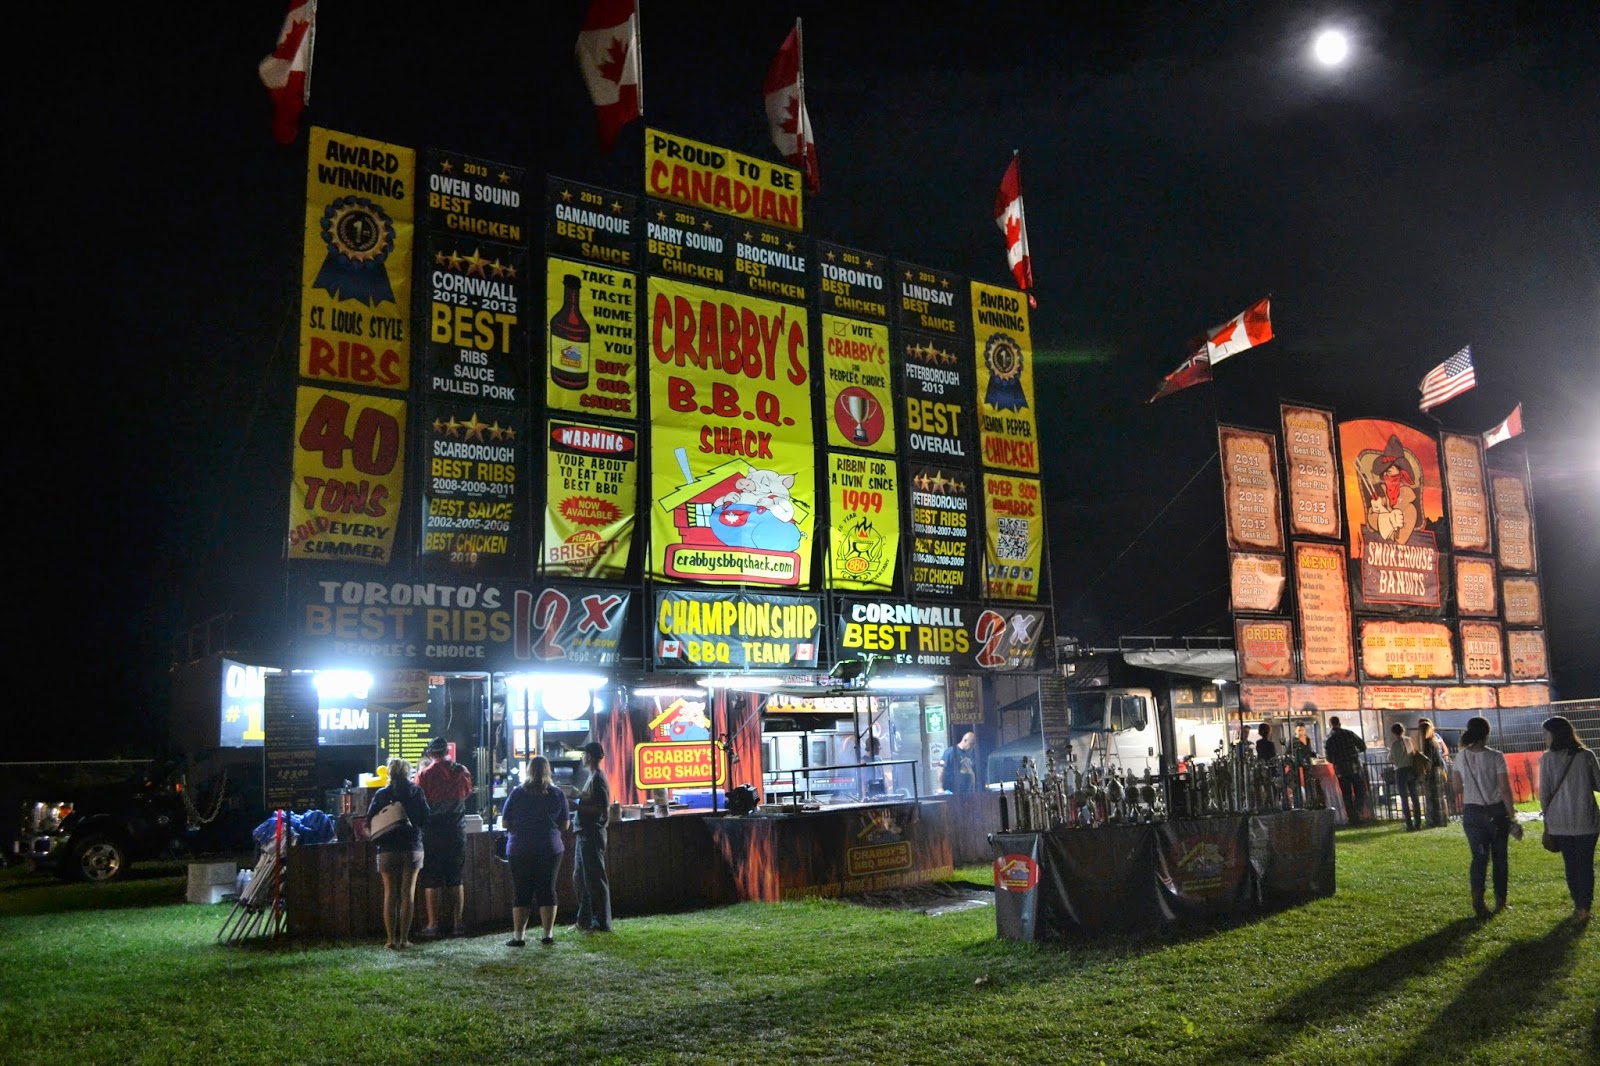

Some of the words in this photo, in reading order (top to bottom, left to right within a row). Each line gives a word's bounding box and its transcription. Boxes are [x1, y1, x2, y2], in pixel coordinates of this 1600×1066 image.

[326, 140, 398, 174] AWARD
[653, 135, 725, 170] PROUD
[736, 159, 760, 181] TO
[770, 169, 795, 191] BE
[463, 163, 488, 177] 2013
[318, 163, 404, 200] WINNING
[430, 174, 470, 198] OWEN
[474, 184, 520, 208] SOUND
[429, 192, 471, 215] BEST
[580, 191, 603, 205] 2013
[650, 159, 798, 228] CANADIAN
[447, 213, 520, 241] CHICKEN
[555, 203, 630, 235] GANANOQUE
[675, 212, 695, 225] 2013
[556, 220, 595, 242] BEST
[647, 222, 683, 246] PARRY
[685, 232, 723, 254] SOUND
[760, 232, 780, 245] 2013
[581, 241, 631, 266] SAUCE
[647, 241, 682, 259] BEST
[736, 242, 805, 273] BROCKVILLE
[842, 252, 860, 265] 2013
[662, 258, 723, 283] CHICKEN
[735, 257, 767, 279] BEST
[821, 262, 883, 290] TORONTO
[918, 272, 935, 284] 2013
[432, 271, 517, 302] CORNWALL
[581, 269, 615, 286] TAKE
[622, 277, 632, 290] A
[749, 276, 805, 300] CHICKEN
[821, 279, 851, 296] BEST
[433, 290, 468, 306] 2012
[482, 299, 517, 314] 2013
[590, 288, 632, 306] TASTE
[902, 282, 954, 307] LINDSAY
[979, 291, 1019, 314] AWARD
[593, 306, 632, 323] HOME
[834, 296, 886, 319] CHICKEN
[902, 297, 929, 315] BEST
[310, 306, 325, 330] ST.
[332, 312, 362, 338] LOUIS
[369, 316, 403, 342] STYLE
[431, 301, 518, 353] BEST
[851, 323, 873, 338] VOTE
[919, 313, 956, 334] SAUCE
[977, 308, 1024, 333] WINNING
[595, 324, 632, 339] WITH
[652, 292, 807, 386] CRABBY'S
[460, 349, 488, 366] RIBS
[605, 341, 632, 355] YOU
[827, 336, 885, 365] CRABBY'S
[309, 336, 401, 385] RIBS
[595, 358, 630, 376] BUY
[454, 365, 495, 382] SAUCE
[829, 367, 858, 385] PEOPLE'S
[861, 373, 886, 389] CHOICE
[905, 362, 960, 387] PETERBOROUGH
[432, 376, 479, 397] PULLED
[482, 384, 515, 401] PORK
[596, 377, 631, 395] OUR
[921, 381, 945, 396] 2013
[580, 394, 632, 413] SAUCE
[668, 376, 795, 426] B.B.Q.
[906, 396, 961, 437] BEST
[982, 413, 1003, 432] LEMON
[1006, 418, 1032, 438] PEPPER
[299, 395, 399, 476] 40
[562, 428, 624, 450] WARNING
[698, 425, 773, 460] SHACK
[909, 433, 965, 457] OVERALL
[1294, 432, 1321, 445] 2011
[433, 440, 515, 463] SCARBOROUGH
[985, 434, 1034, 470] CHICKEN
[1235, 454, 1259, 466] 2011
[1293, 445, 1309, 455] Best
[1310, 448, 1326, 458] Ribs
[431, 457, 473, 481] BEST
[477, 461, 516, 483] RIBS
[557, 453, 584, 468] YOUR
[591, 458, 628, 472] ABOUT
[837, 458, 866, 474] RIBBIN
[870, 462, 887, 475] FOR
[1299, 464, 1327, 477] 2012
[1451, 457, 1473, 467] 2012
[560, 466, 573, 479] TO
[577, 469, 597, 481] EAT
[603, 472, 624, 483] THE
[831, 473, 837, 486] A
[868, 477, 894, 491] SINCE
[432, 477, 515, 495] 2008-2009-2011
[563, 478, 589, 493] BEST
[595, 482, 618, 495] BBQ
[987, 478, 1013, 497] OVER
[1297, 479, 1312, 489] Best
[1313, 481, 1328, 491] Ribs
[1456, 486, 1478, 496] 2013
[303, 476, 388, 517] TONS
[578, 500, 600, 509] NOW
[842, 489, 883, 515] 1999
[913, 491, 968, 511] PETERBOROUGH
[1239, 491, 1264, 503] 2012
[1299, 500, 1326, 513] 2013
[429, 499, 466, 517] BEST
[468, 500, 513, 520] SAUCE
[566, 507, 613, 520] AVAILABLE
[914, 507, 938, 524] BEST
[940, 511, 967, 528] RIBS
[1239, 503, 1253, 513] Best
[1254, 505, 1268, 514] Ribs
[1240, 518, 1266, 530] 2013
[1297, 514, 1312, 523] Best
[1313, 516, 1329, 525] Ribs
[329, 521, 390, 540] EVERY
[572, 533, 597, 542] REAL
[1241, 530, 1255, 539] Best
[1256, 531, 1271, 540] Ribs
[303, 539, 385, 560] SUMMER
[425, 532, 455, 551] BEST
[456, 534, 508, 554] CHICKEN
[549, 540, 618, 562] BRISKET
[914, 537, 933, 553] BEST
[934, 539, 967, 556] SAUCE
[676, 553, 793, 573] crabbysbbqshack.com
[849, 560, 866, 570] BBQ
[1300, 554, 1338, 570] MENU
[1368, 541, 1434, 571] SMOKEHOUSE
[929, 568, 964, 585] CHICKEN
[1379, 570, 1426, 597] BANDITS
[320, 580, 501, 608] TORONTO'S
[305, 604, 413, 640] BEST
[426, 607, 511, 642] RIBS
[659, 598, 818, 639] CHAMPIONSHIP
[851, 603, 965, 627] CORNWALL
[842, 621, 912, 651] BEST
[918, 626, 971, 654] RIBS
[974, 609, 1007, 668] 2
[1246, 627, 1284, 641] ORDER
[425, 644, 485, 659] CHOICE
[687, 641, 730, 664] BBQ
[742, 642, 791, 664] TEAM
[1246, 642, 1286, 657] HERE
[1468, 641, 1498, 655] WANTED
[917, 655, 951, 666] CHOICE
[1468, 658, 1491, 670] RIBS
[958, 679, 971, 687] WE
[955, 690, 975, 698] HAVE
[319, 708, 370, 730] TEAM
[950, 712, 982, 721] BRISKET
[643, 748, 718, 764] CRABBY'S
[643, 764, 671, 780] BBQ
